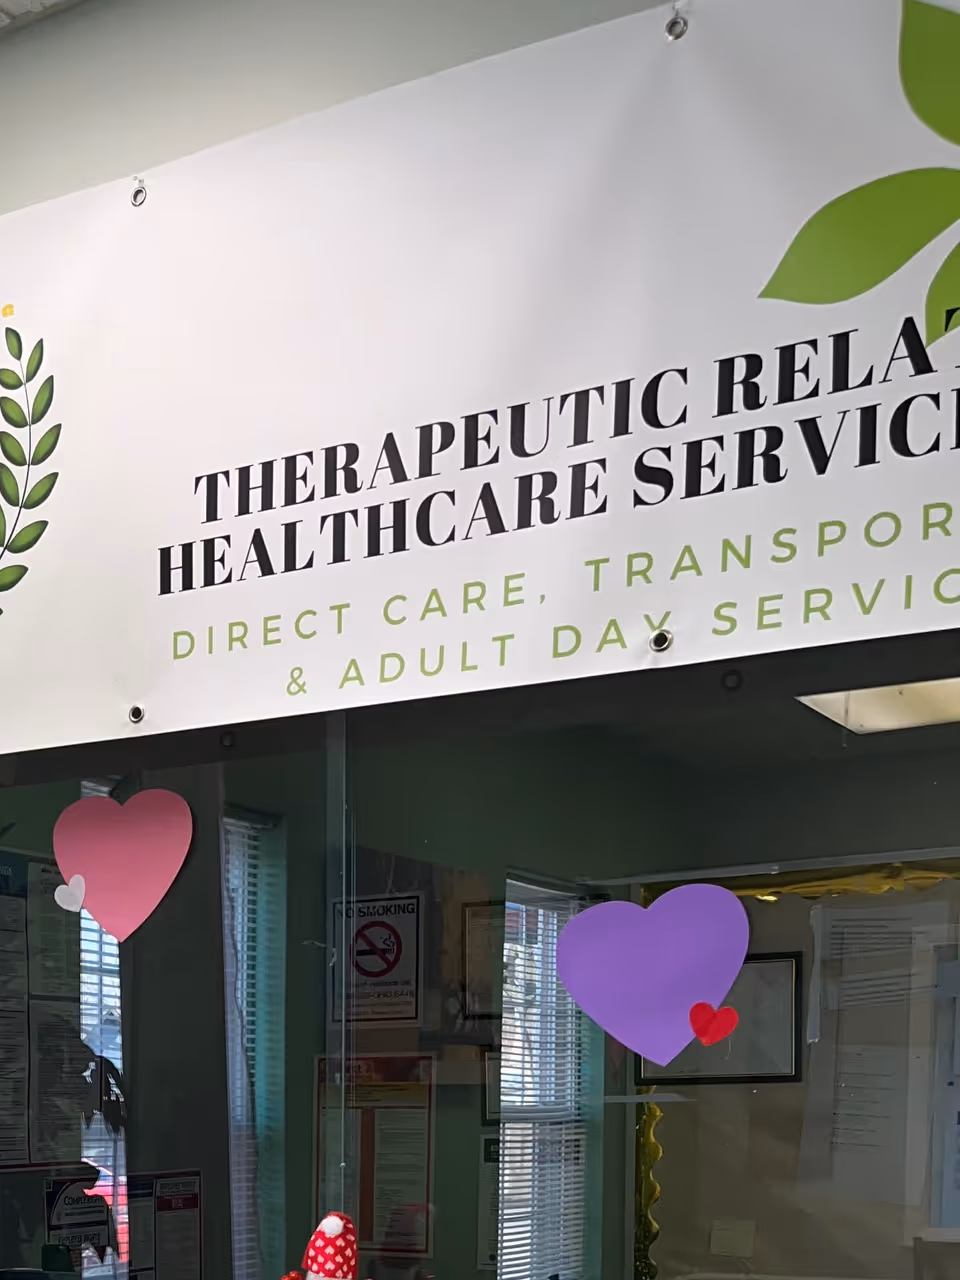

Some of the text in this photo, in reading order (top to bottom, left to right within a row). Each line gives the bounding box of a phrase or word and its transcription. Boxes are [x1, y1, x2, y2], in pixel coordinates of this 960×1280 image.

[194, 368, 688, 523] THERAPEUTIC
[158, 457, 607, 596] HEALTHCARE
[172, 501, 954, 660] DIRECT CARE, TRANSPOR
[286, 666, 308, 697] &
[339, 634, 514, 690] ADULT
[552, 611, 672, 659] DAY
[358, 903, 416, 918] SMOKING
